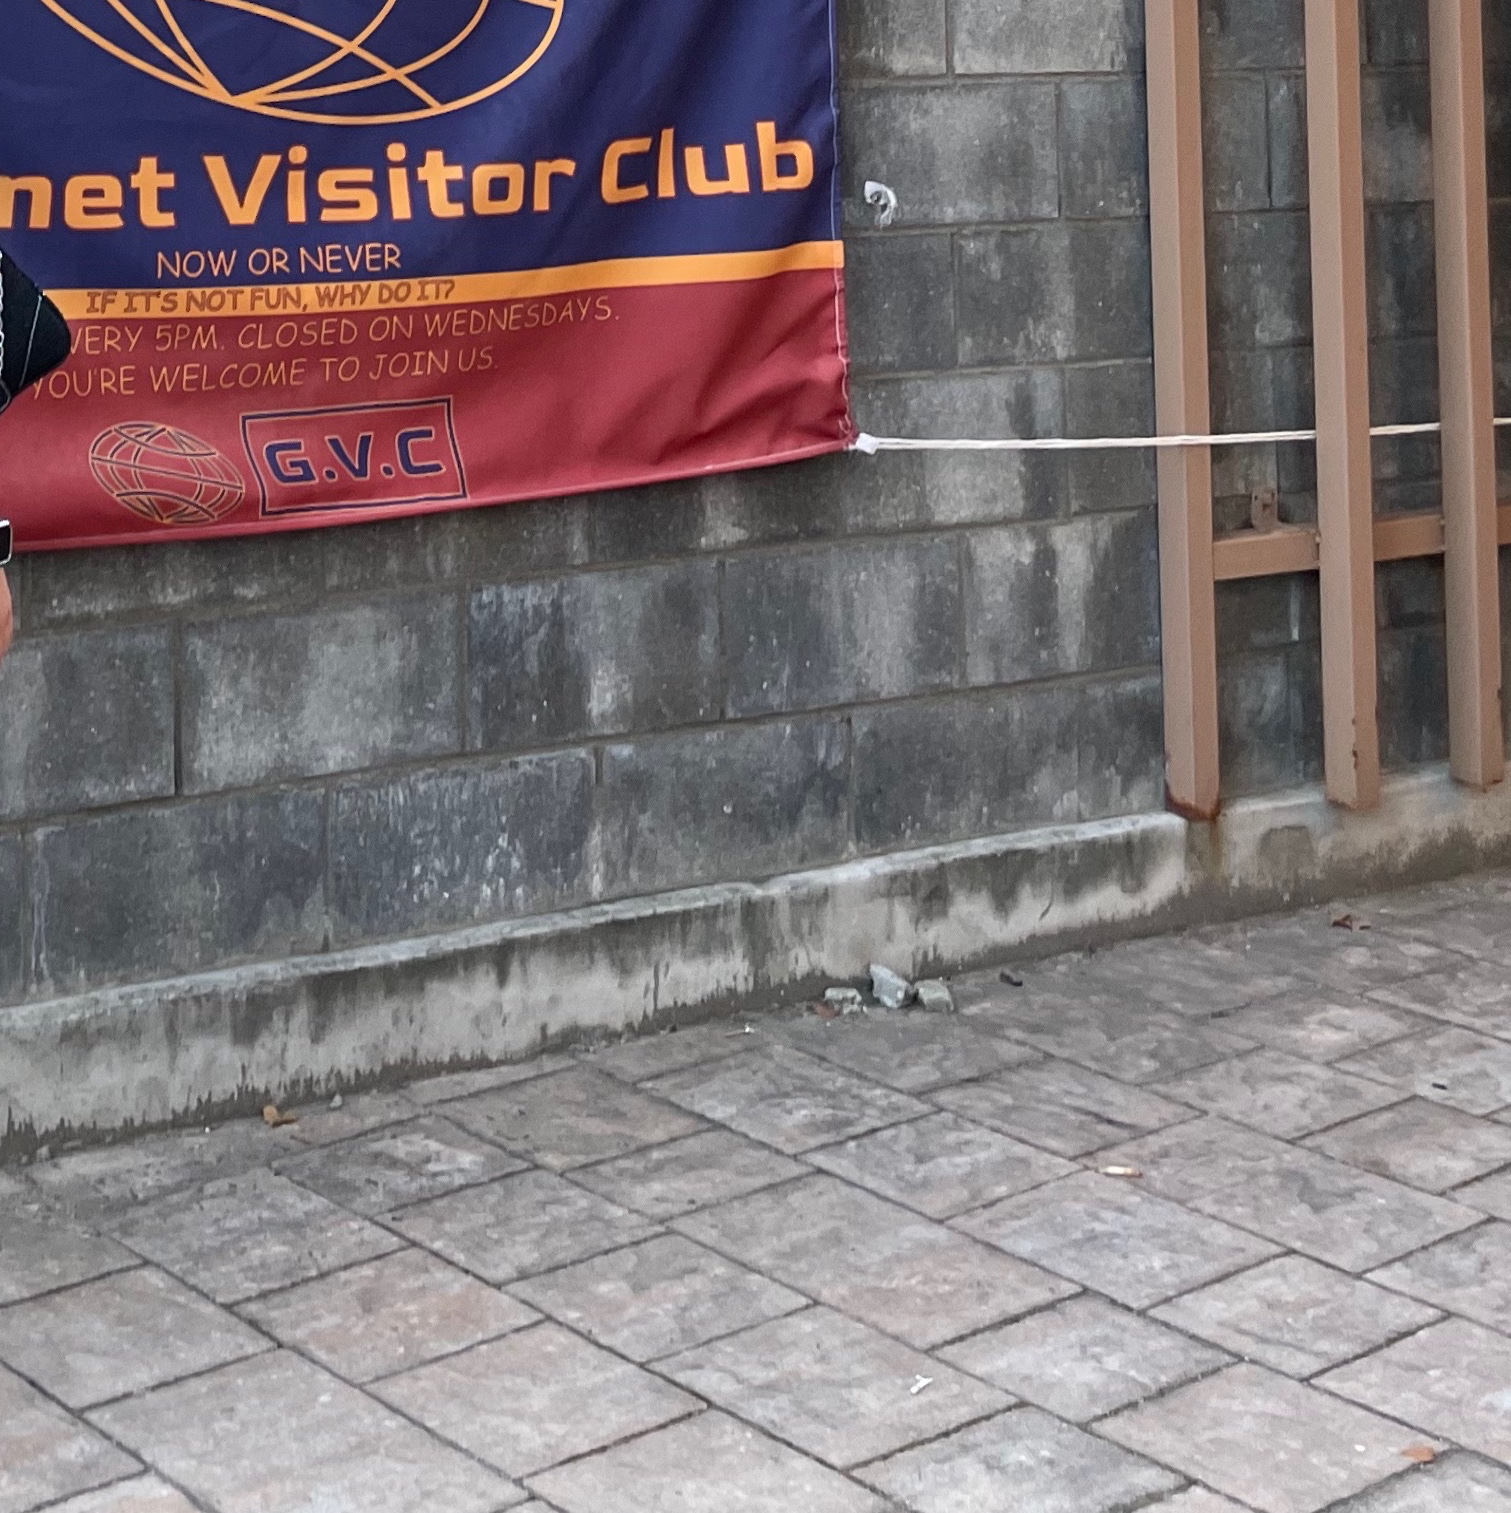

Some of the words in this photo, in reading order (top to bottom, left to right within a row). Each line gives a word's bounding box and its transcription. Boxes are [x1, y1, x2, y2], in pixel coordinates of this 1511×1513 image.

[202, 142, 577, 226] Visitor
[600, 120, 815, 205] Club
[156, 249, 238, 279] NOW
[248, 247, 290, 276] OR
[299, 242, 402, 274] NEVER
[85, 290, 118, 315] IF
[123, 289, 178, 314] IT'S
[185, 288, 244, 313] NOT
[249, 286, 308, 313] FUN,
[314, 283, 371, 308] WHY
[378, 280, 412, 305] DO
[416, 278, 455, 301] IT?
[154, 322, 225, 352] 5PM.
[237, 317, 358, 350] CLOSED
[368, 313, 413, 342] ON
[424, 294, 620, 337] WEDNESDAYS.
[149, 357, 308, 394] WELCOME
[319, 355, 360, 383] TO
[368, 348, 448, 381] JOIN
[457, 345, 499, 373] US.
[262, 426, 446, 486] G.V.C
